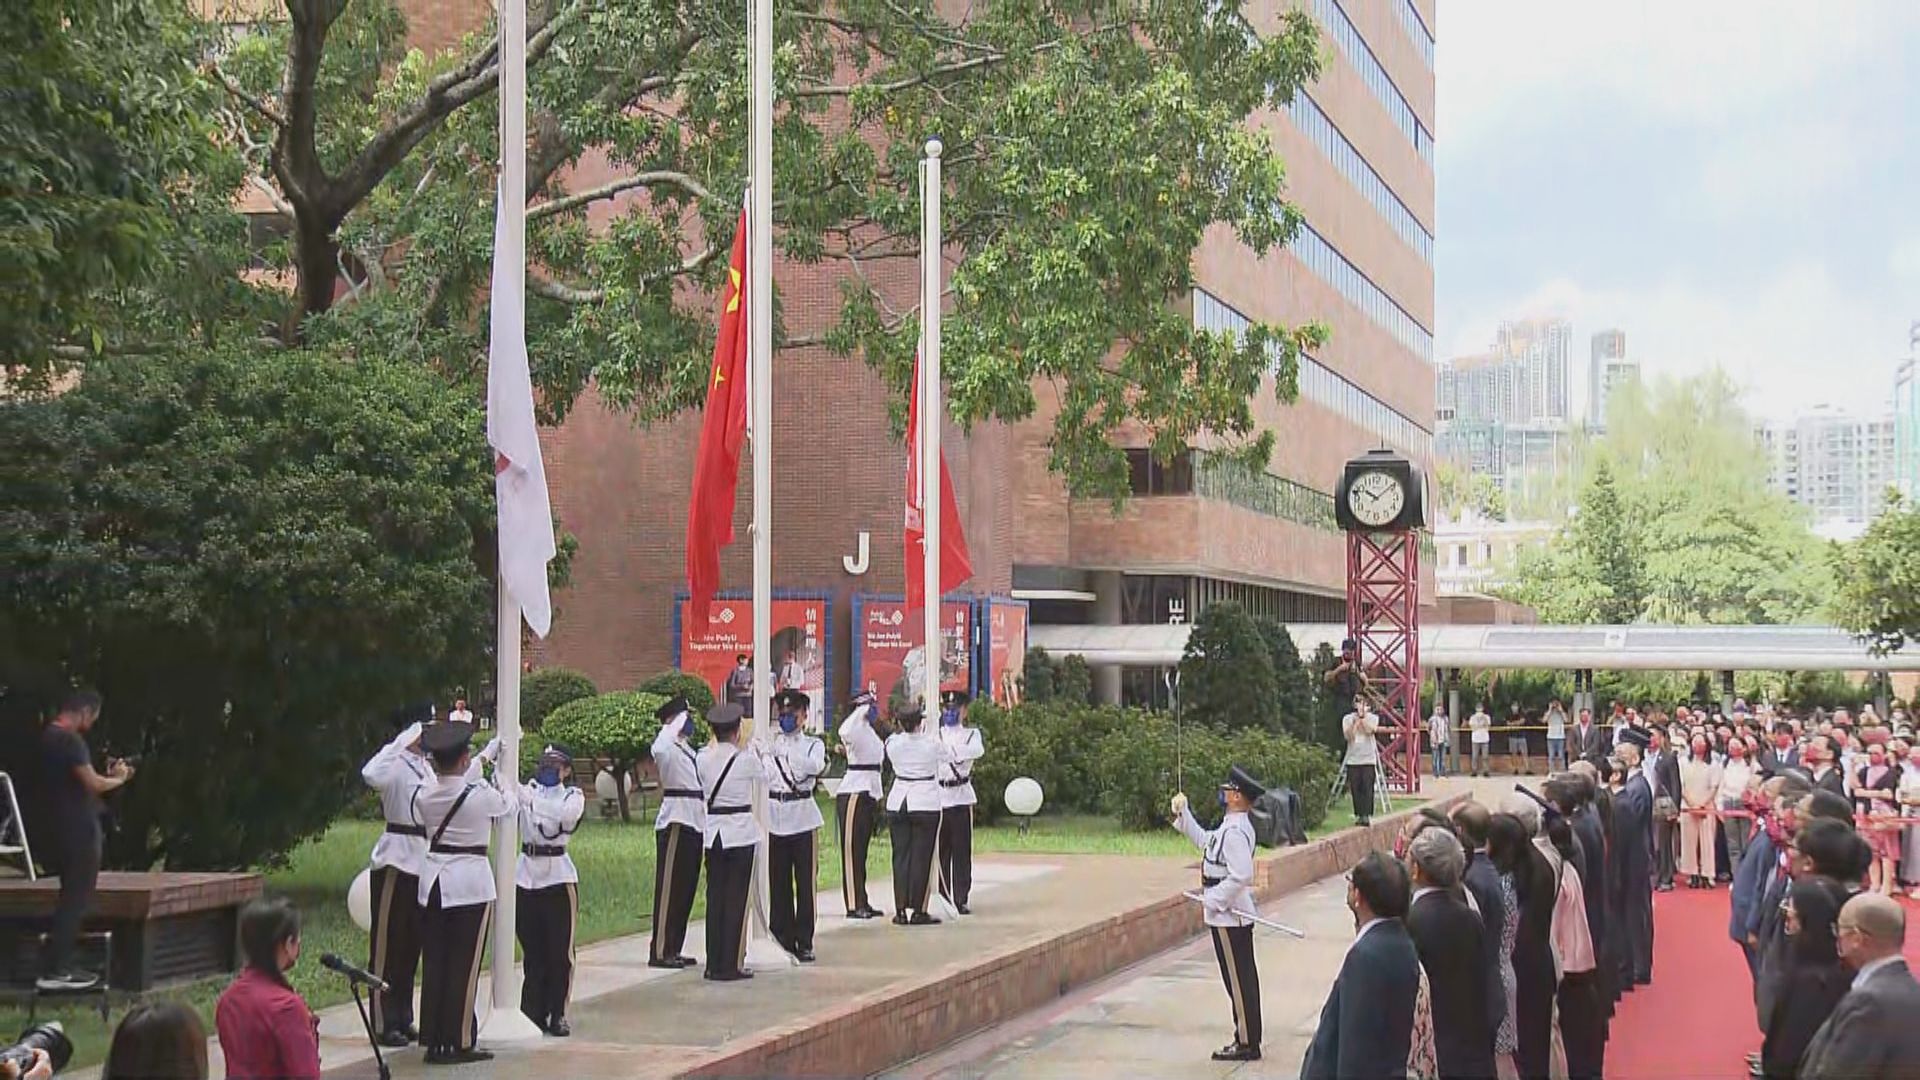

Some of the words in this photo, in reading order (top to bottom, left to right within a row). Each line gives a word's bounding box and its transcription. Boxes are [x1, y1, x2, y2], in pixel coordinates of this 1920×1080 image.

[843, 532, 870, 575] J
[715, 633, 737, 643] PolyU
[689, 642, 721, 651] Together
